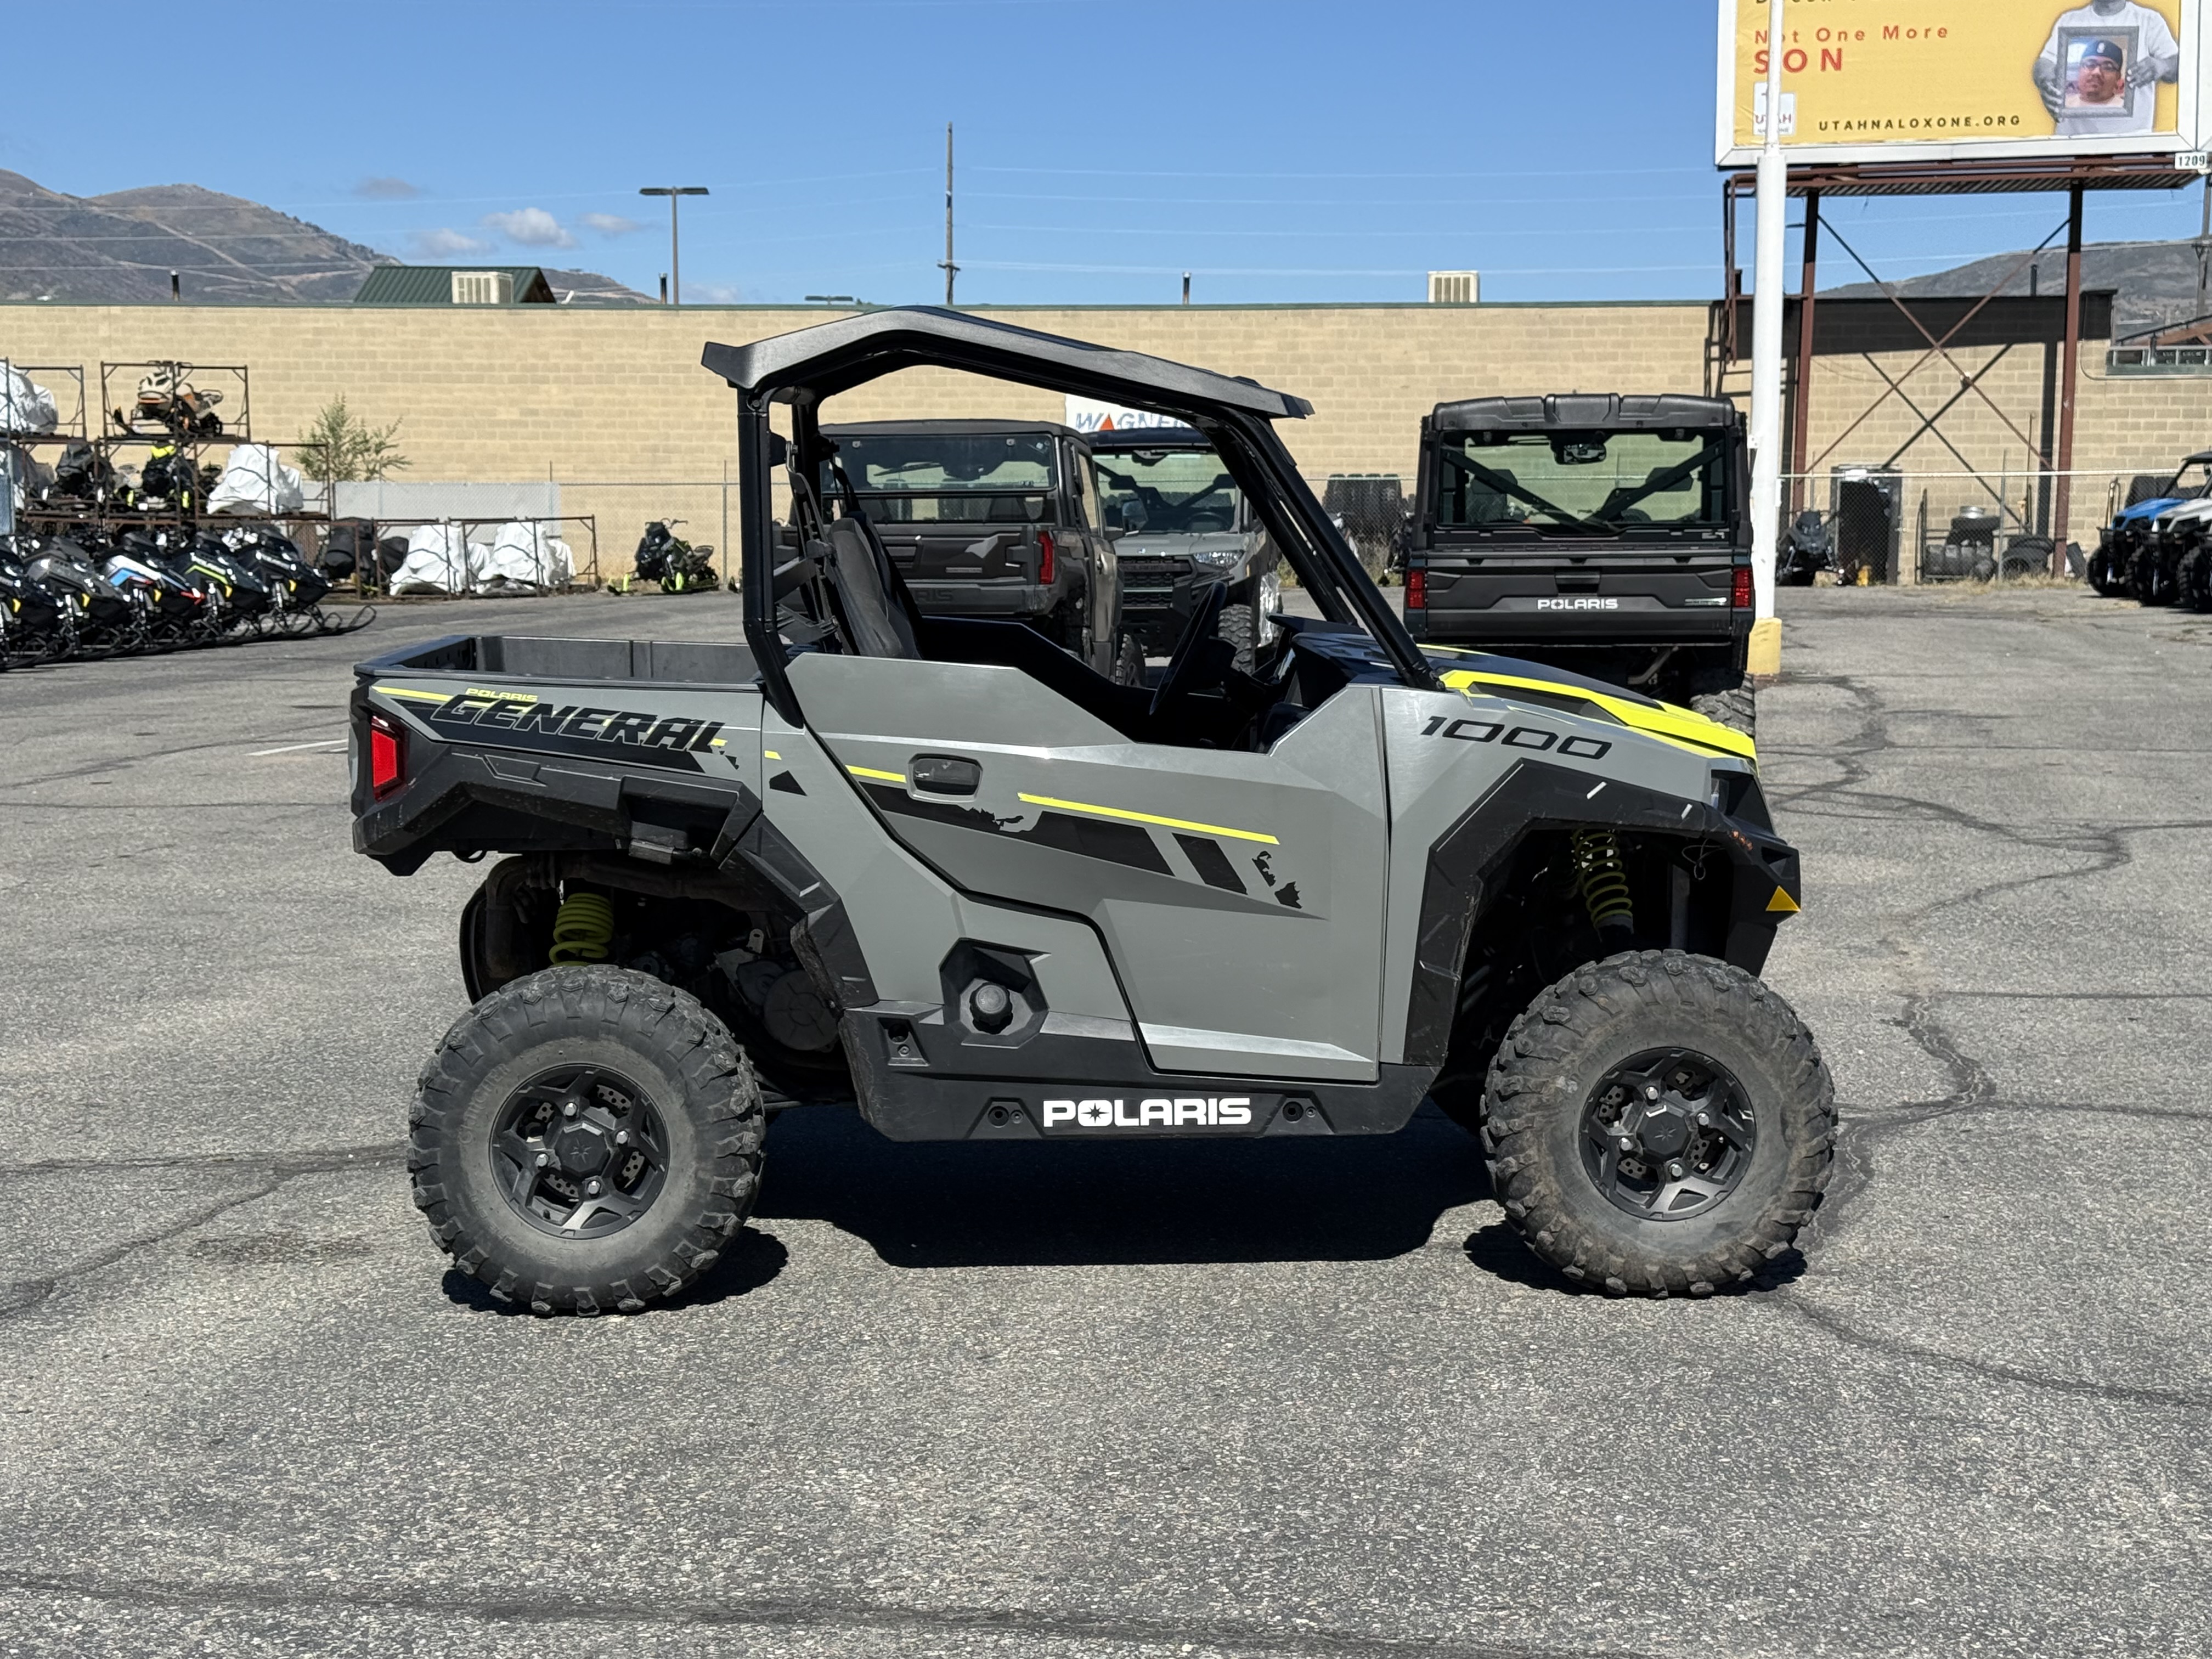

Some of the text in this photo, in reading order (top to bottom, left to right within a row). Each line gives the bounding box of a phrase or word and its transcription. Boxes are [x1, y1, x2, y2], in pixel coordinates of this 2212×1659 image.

[1755, 25, 1948, 44] Nt One More
[1753, 48, 1842, 74] SON
[1819, 115, 2020, 131] UTAHNALOXONE.ORG
[2179, 155, 2205, 167] 1209
[1537, 599, 1618, 610] POLARIS
[465, 688, 538, 702] POLARIS
[430, 694, 726, 753] GENERAL
[1420, 716, 1612, 760] 1000
[1043, 1098, 1252, 1127] POLARIS
